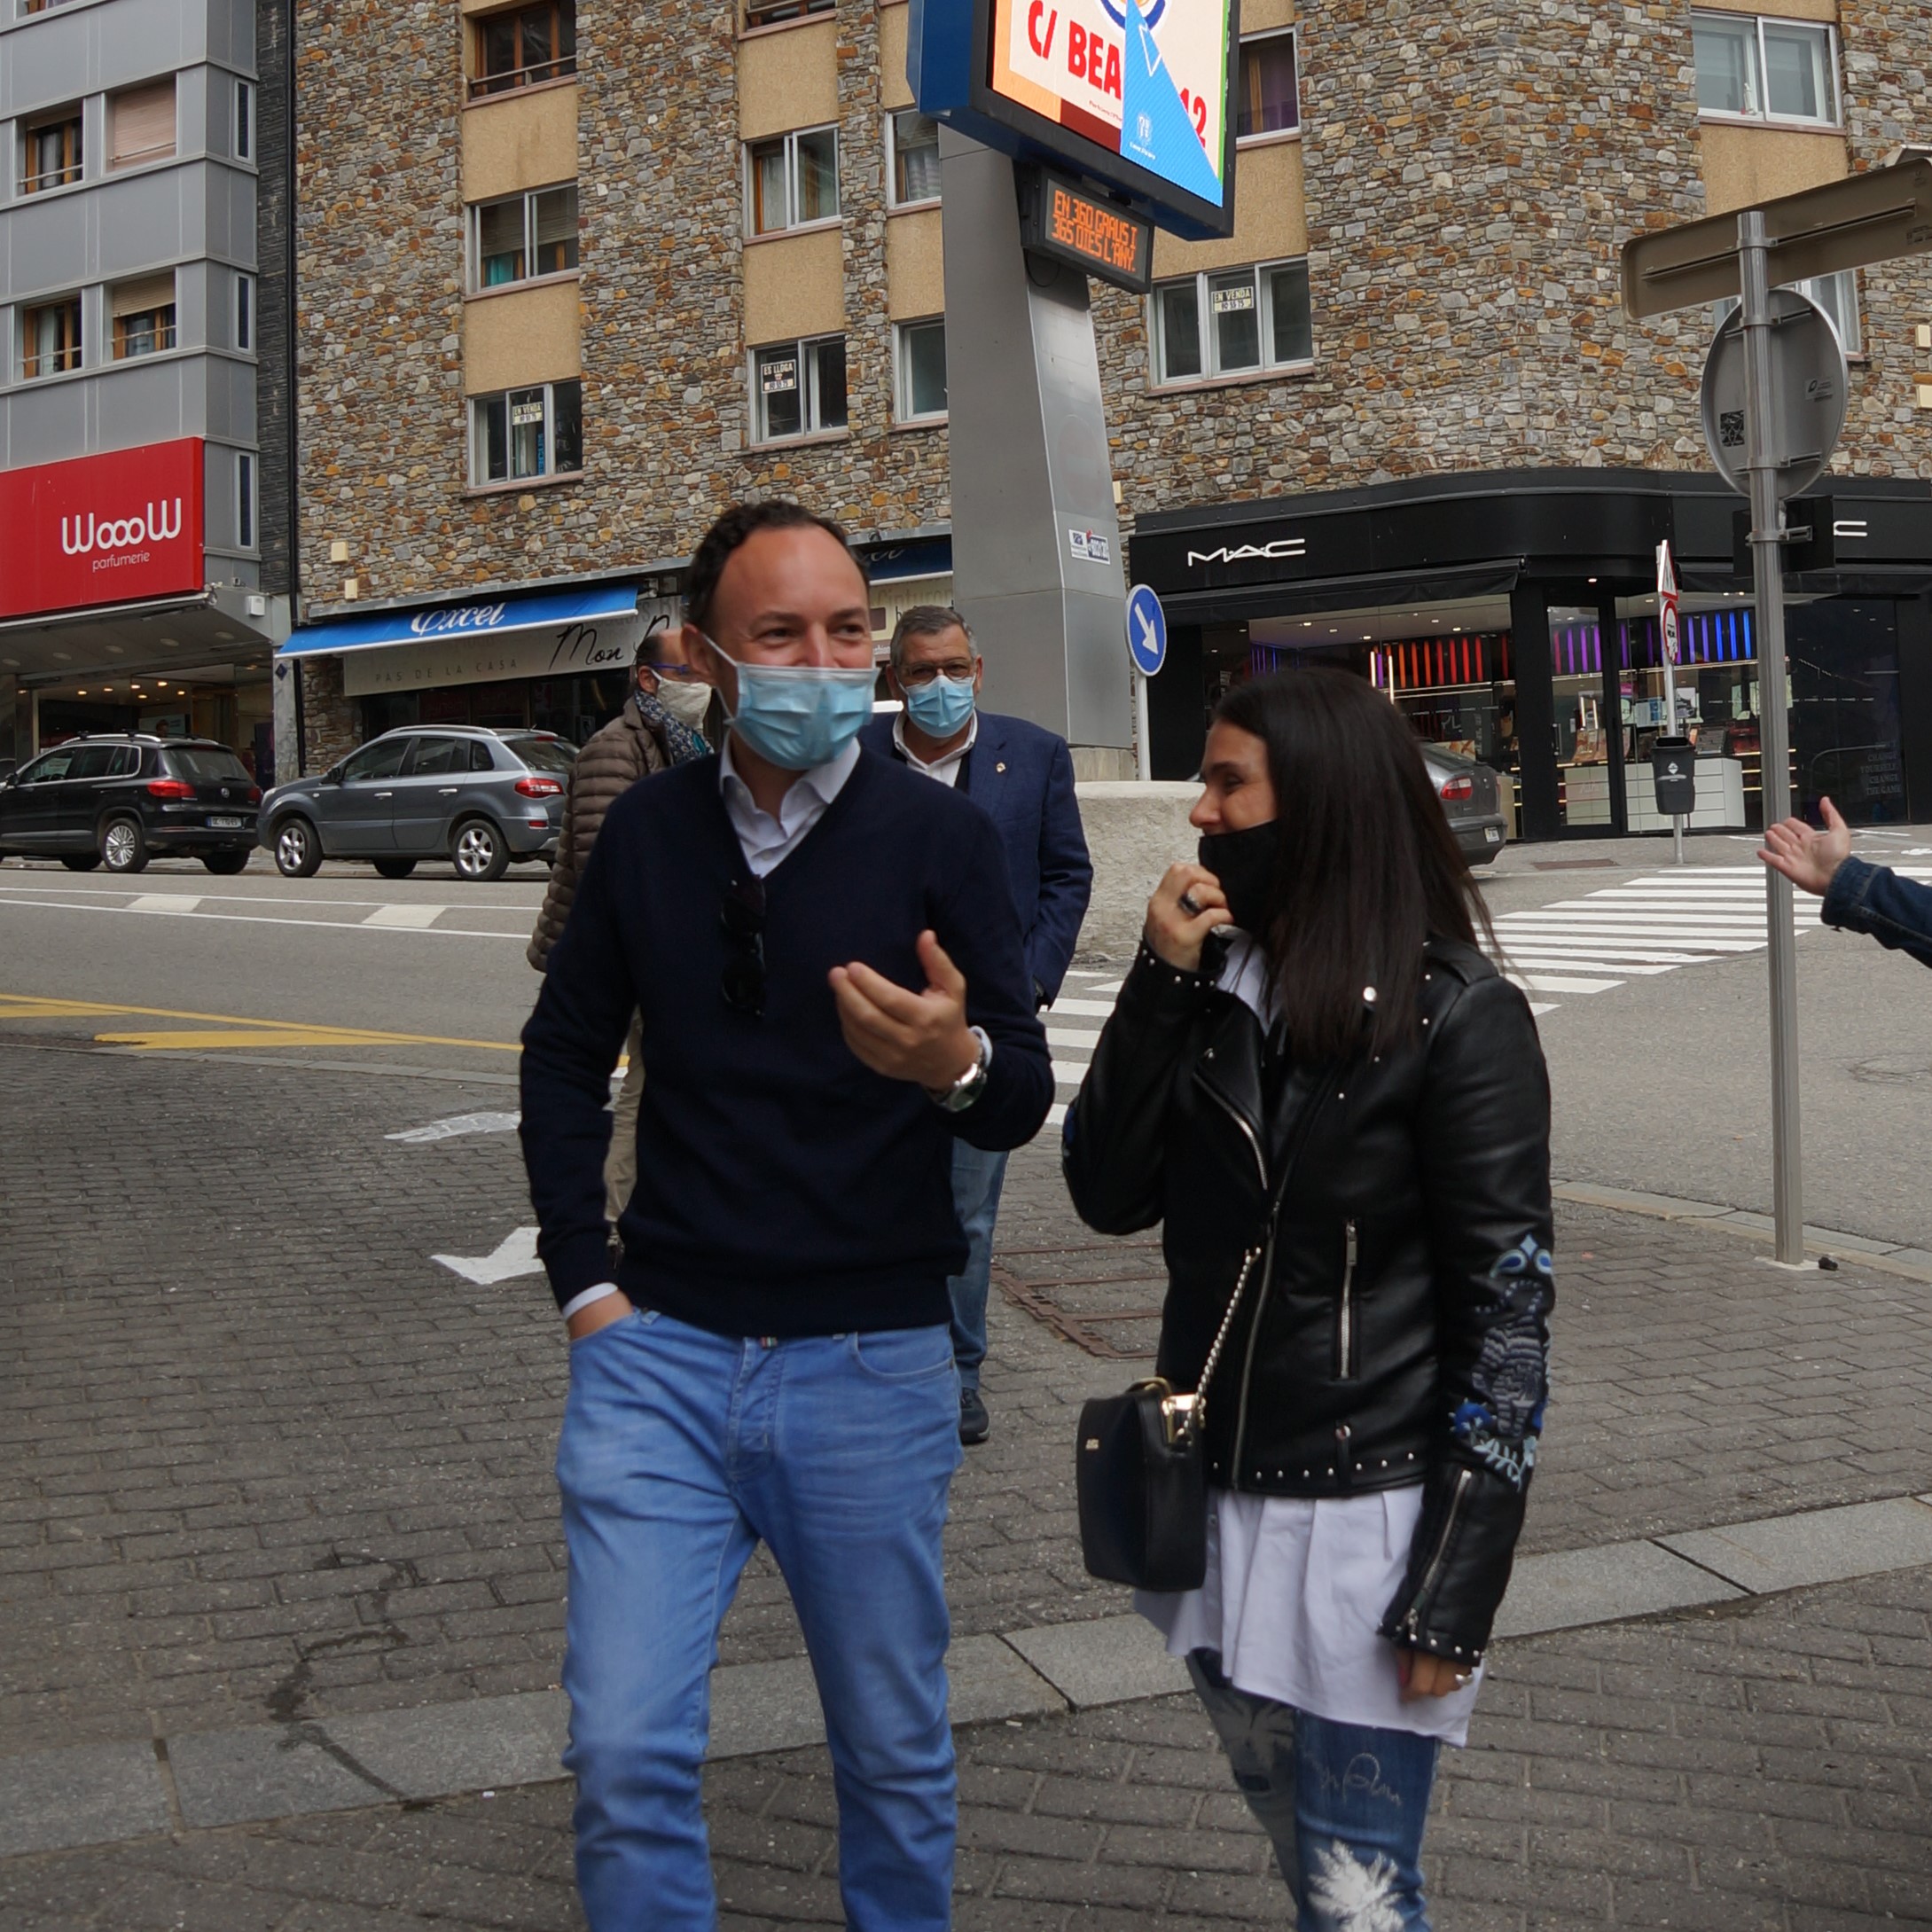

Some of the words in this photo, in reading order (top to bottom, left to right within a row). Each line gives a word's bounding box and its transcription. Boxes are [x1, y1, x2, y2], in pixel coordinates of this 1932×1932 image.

[1028, 0, 1057, 59] C/
[1068, 20, 1122, 100] BEA
[1054, 190, 1070, 218] EN
[1072, 198, 1093, 231] 360
[1094, 209, 1130, 246] GRAUS
[1130, 226, 1138, 250] I
[1052, 213, 1074, 245] 365
[1076, 224, 1103, 258] DIES
[1214, 291, 1224, 302] EN
[1225, 288, 1251, 301] VENDA
[763, 365, 772, 376] ES
[773, 362, 794, 374] LLOGA
[523, 404, 541, 413] VENDA
[92, 551, 151, 573] parfumerie
[1188, 538, 1306, 567] MAC
[411, 602, 507, 637] Excel
[548, 622, 624, 673] Mon
[375, 671, 403, 683] PAS
[415, 668, 433, 680] DE
[446, 665, 463, 677] LA
[475, 659, 518, 673] CASA
[1881, 785, 1901, 794] GAME
